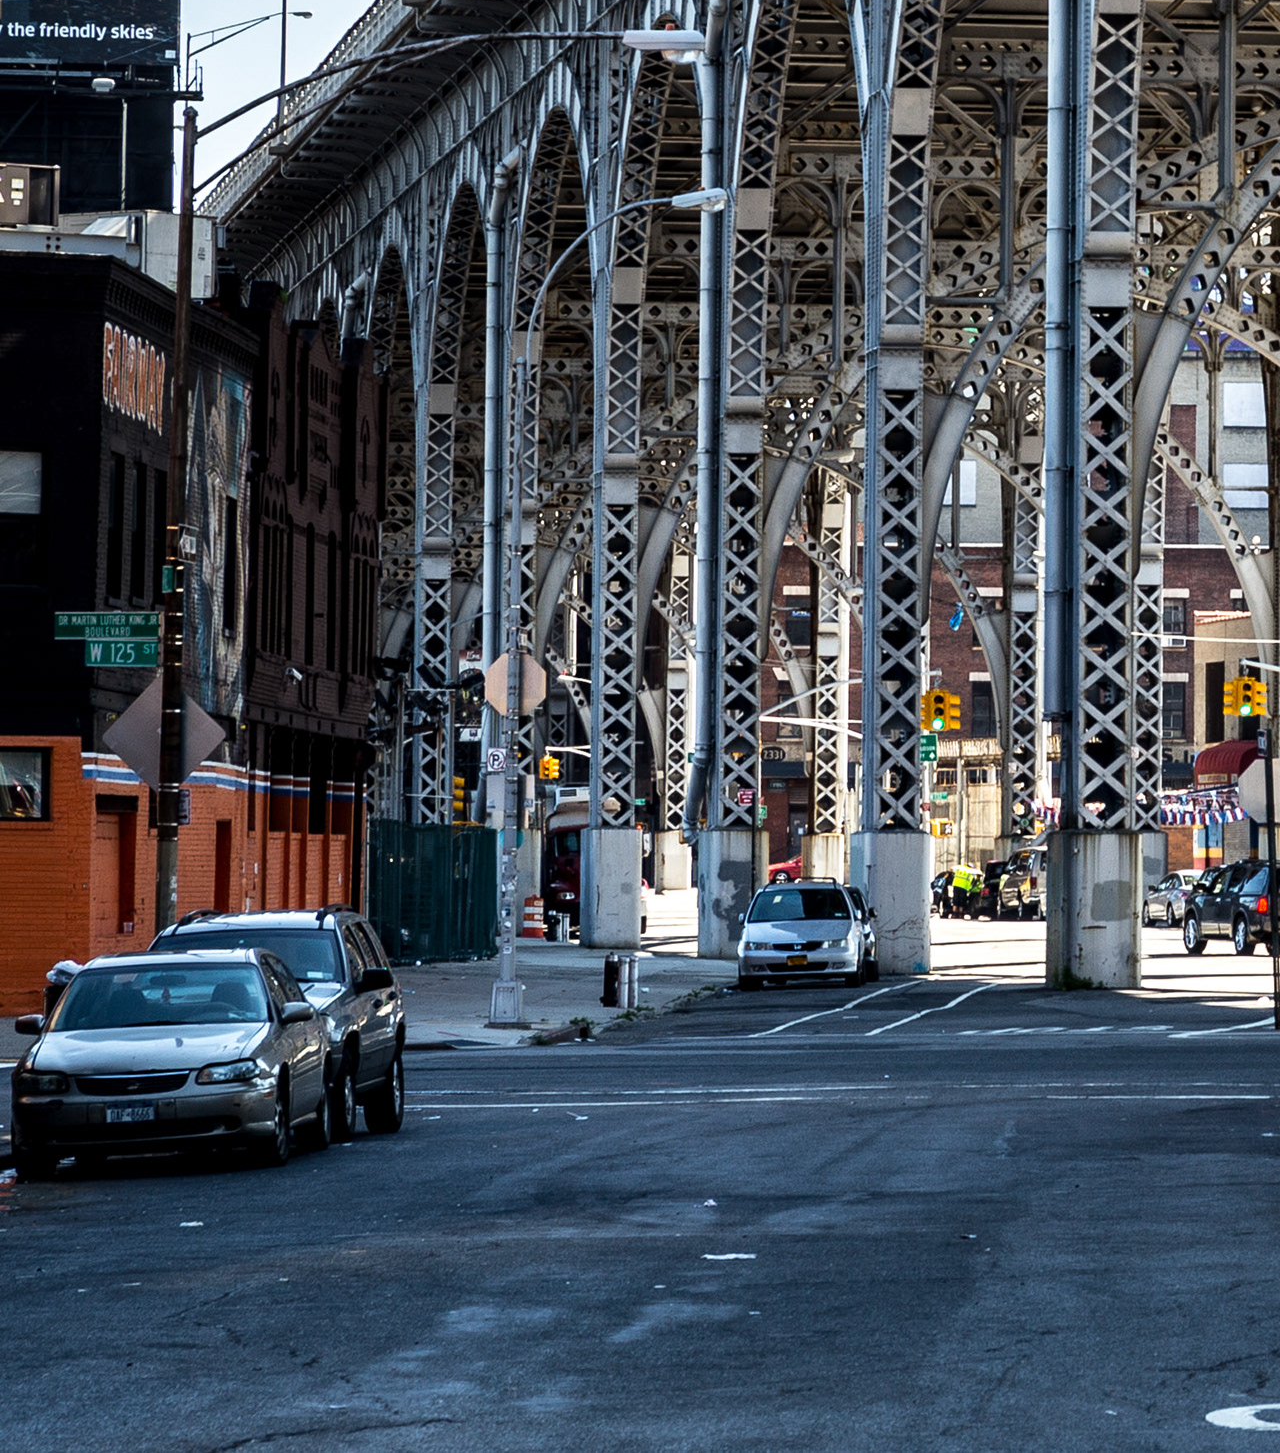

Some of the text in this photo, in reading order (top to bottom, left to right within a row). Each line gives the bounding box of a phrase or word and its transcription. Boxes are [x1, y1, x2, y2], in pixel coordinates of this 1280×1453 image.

[7, 22, 35, 37] the
[39, 22, 107, 41] friendly
[110, 24, 154, 40] skies
[103, 321, 166, 436] FAIRWAY
[58, 615, 157, 625] DR MARTIN LUTHER KING JR
[85, 627, 131, 637] BOULEVARD
[89, 643, 157, 663] W 125 ST
